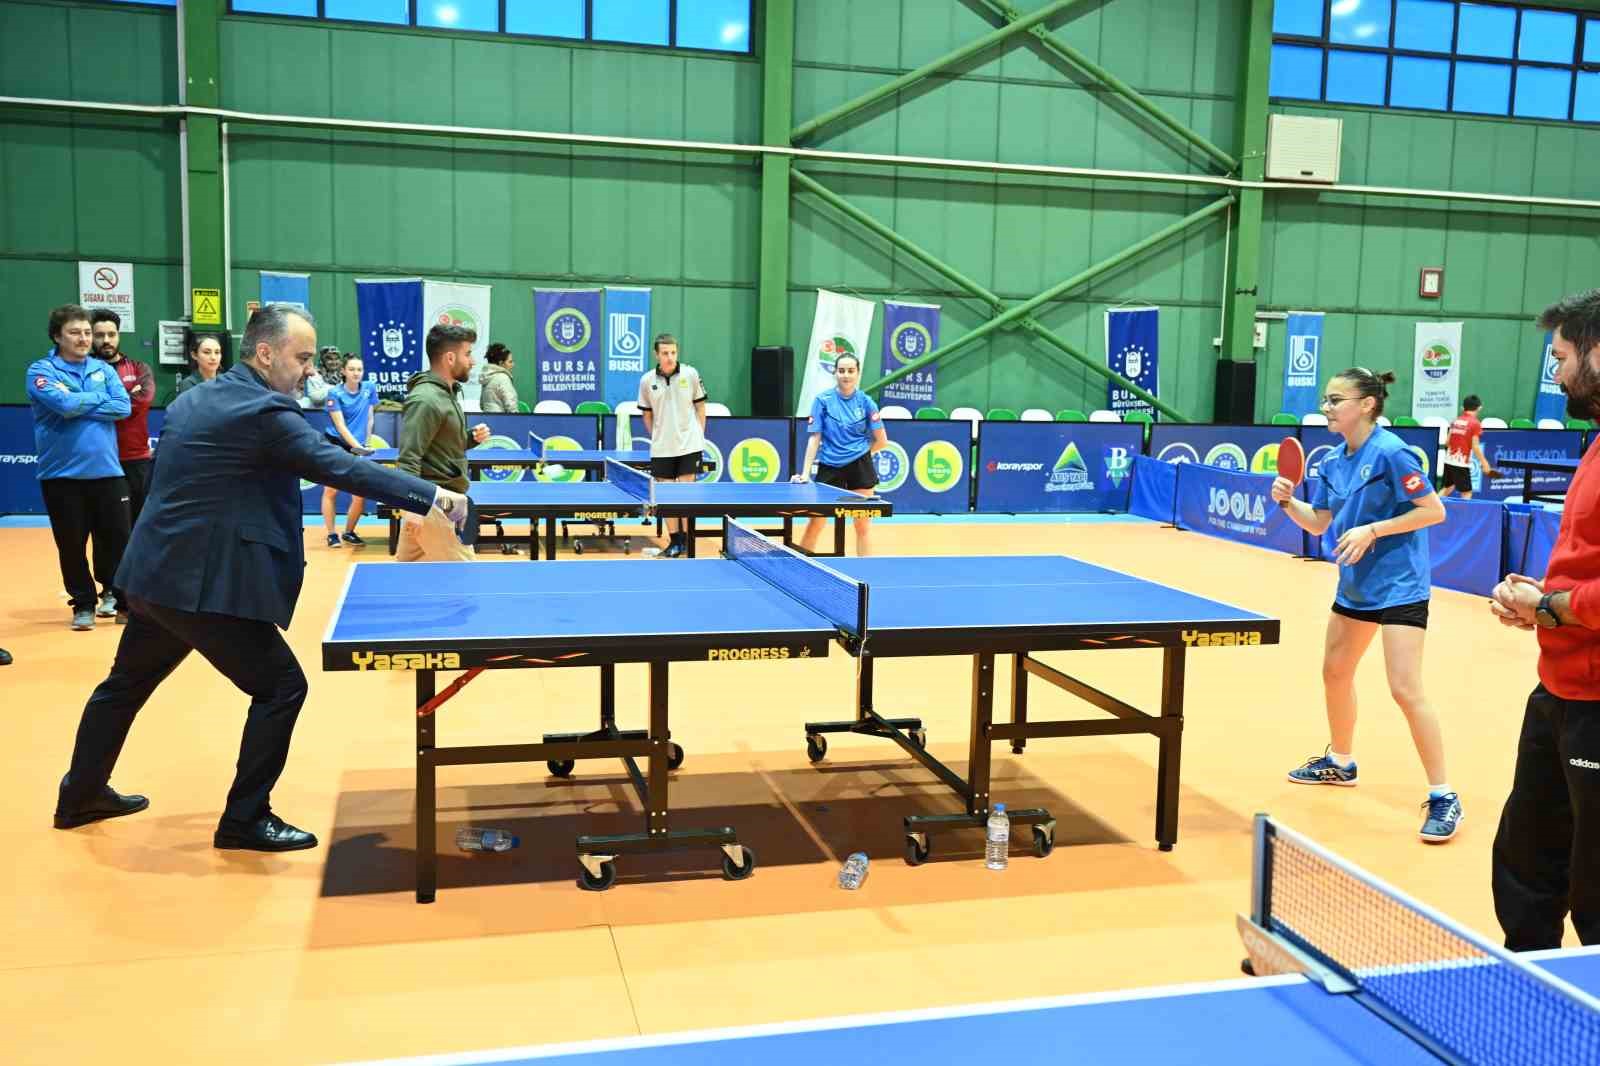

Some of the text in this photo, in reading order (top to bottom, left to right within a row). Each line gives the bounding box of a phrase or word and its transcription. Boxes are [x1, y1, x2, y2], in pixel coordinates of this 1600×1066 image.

[542, 361, 596, 371] BURSA
[367, 372, 411, 383] BURS
[885, 369, 934, 383] BRSA
[1110, 447, 1127, 470] B
[997, 462, 1044, 471] korayspor
[1208, 487, 1265, 523] JOOLA
[574, 511, 618, 519] PROGRESS
[1181, 630, 1261, 647] Yasaka
[352, 651, 460, 671] Yasaka
[708, 647, 790, 661] PROGRESS
[1569, 758, 1600, 770] adidas
